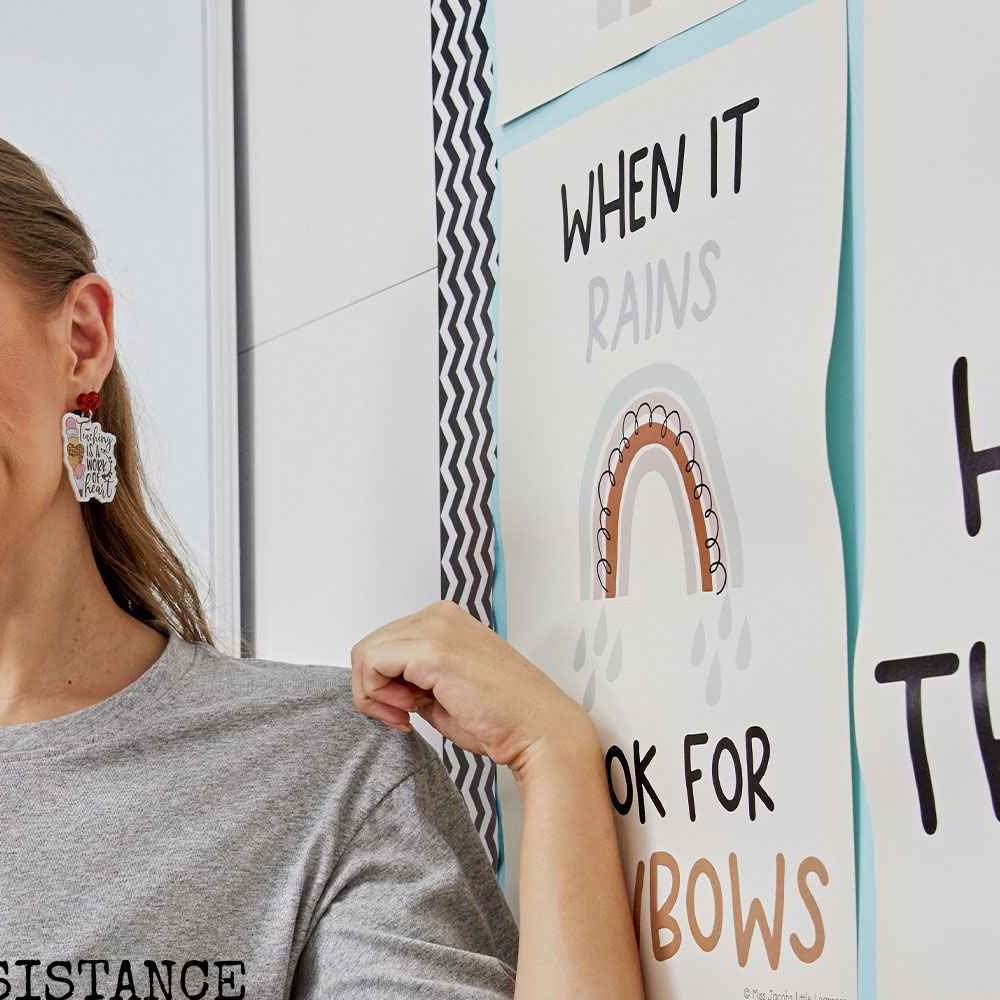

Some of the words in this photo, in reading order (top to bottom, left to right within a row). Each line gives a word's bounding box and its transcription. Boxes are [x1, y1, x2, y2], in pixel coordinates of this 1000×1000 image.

[561, 133, 686, 263] WHEN
[710, 97, 760, 199] IT
[586, 239, 722, 364] RAINS
[76, 418, 114, 454] Teaching
[86, 443, 94, 458] IS
[95, 444, 101, 459] A
[86, 457, 108, 473] WORK
[91, 471, 100, 484] OF
[84, 472, 115, 499] heart
[684, 725, 775, 823] FOR
[752, 988, 766, 1000] Miss
